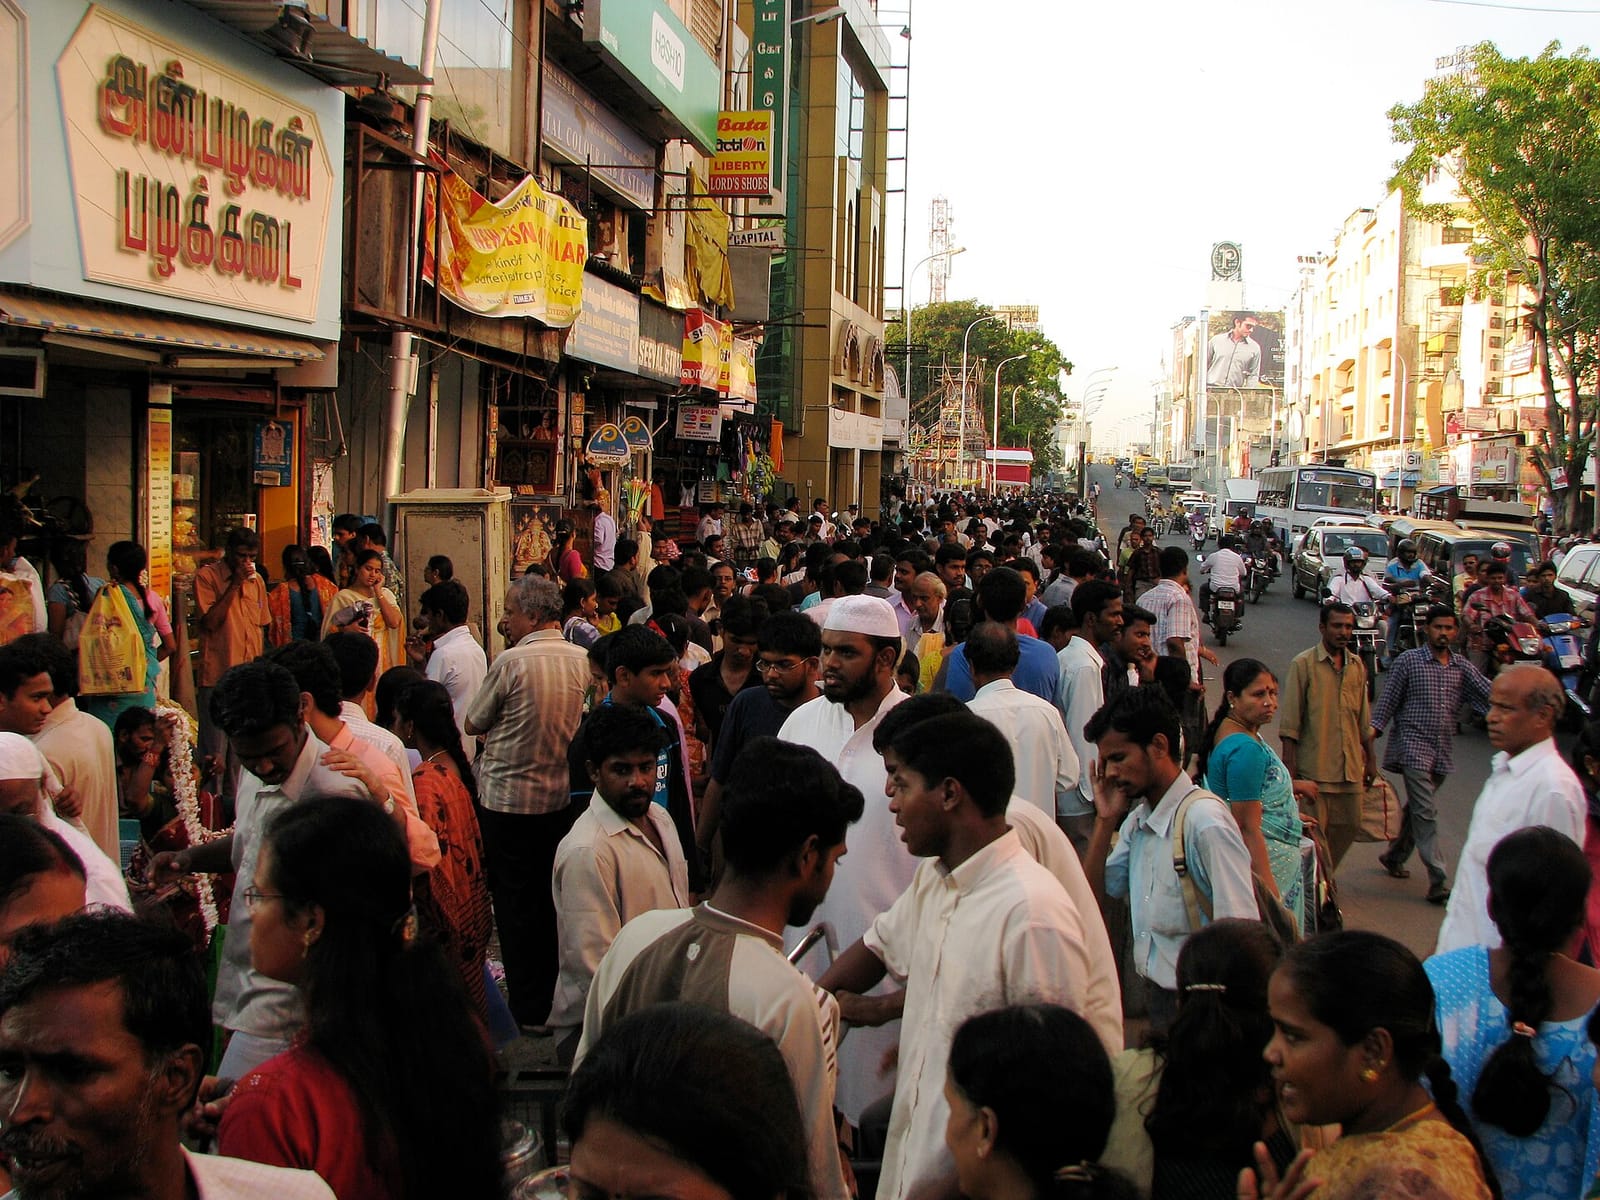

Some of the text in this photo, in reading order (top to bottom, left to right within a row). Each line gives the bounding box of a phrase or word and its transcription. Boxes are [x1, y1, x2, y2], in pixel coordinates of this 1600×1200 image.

[98, 54, 313, 201] அன்பழகன்
[717, 118, 768, 131] Bata
[714, 161, 767, 171] LIBERTY
[711, 177, 768, 190] LORD'S SHOES
[117, 168, 302, 289] பழக்கடை
